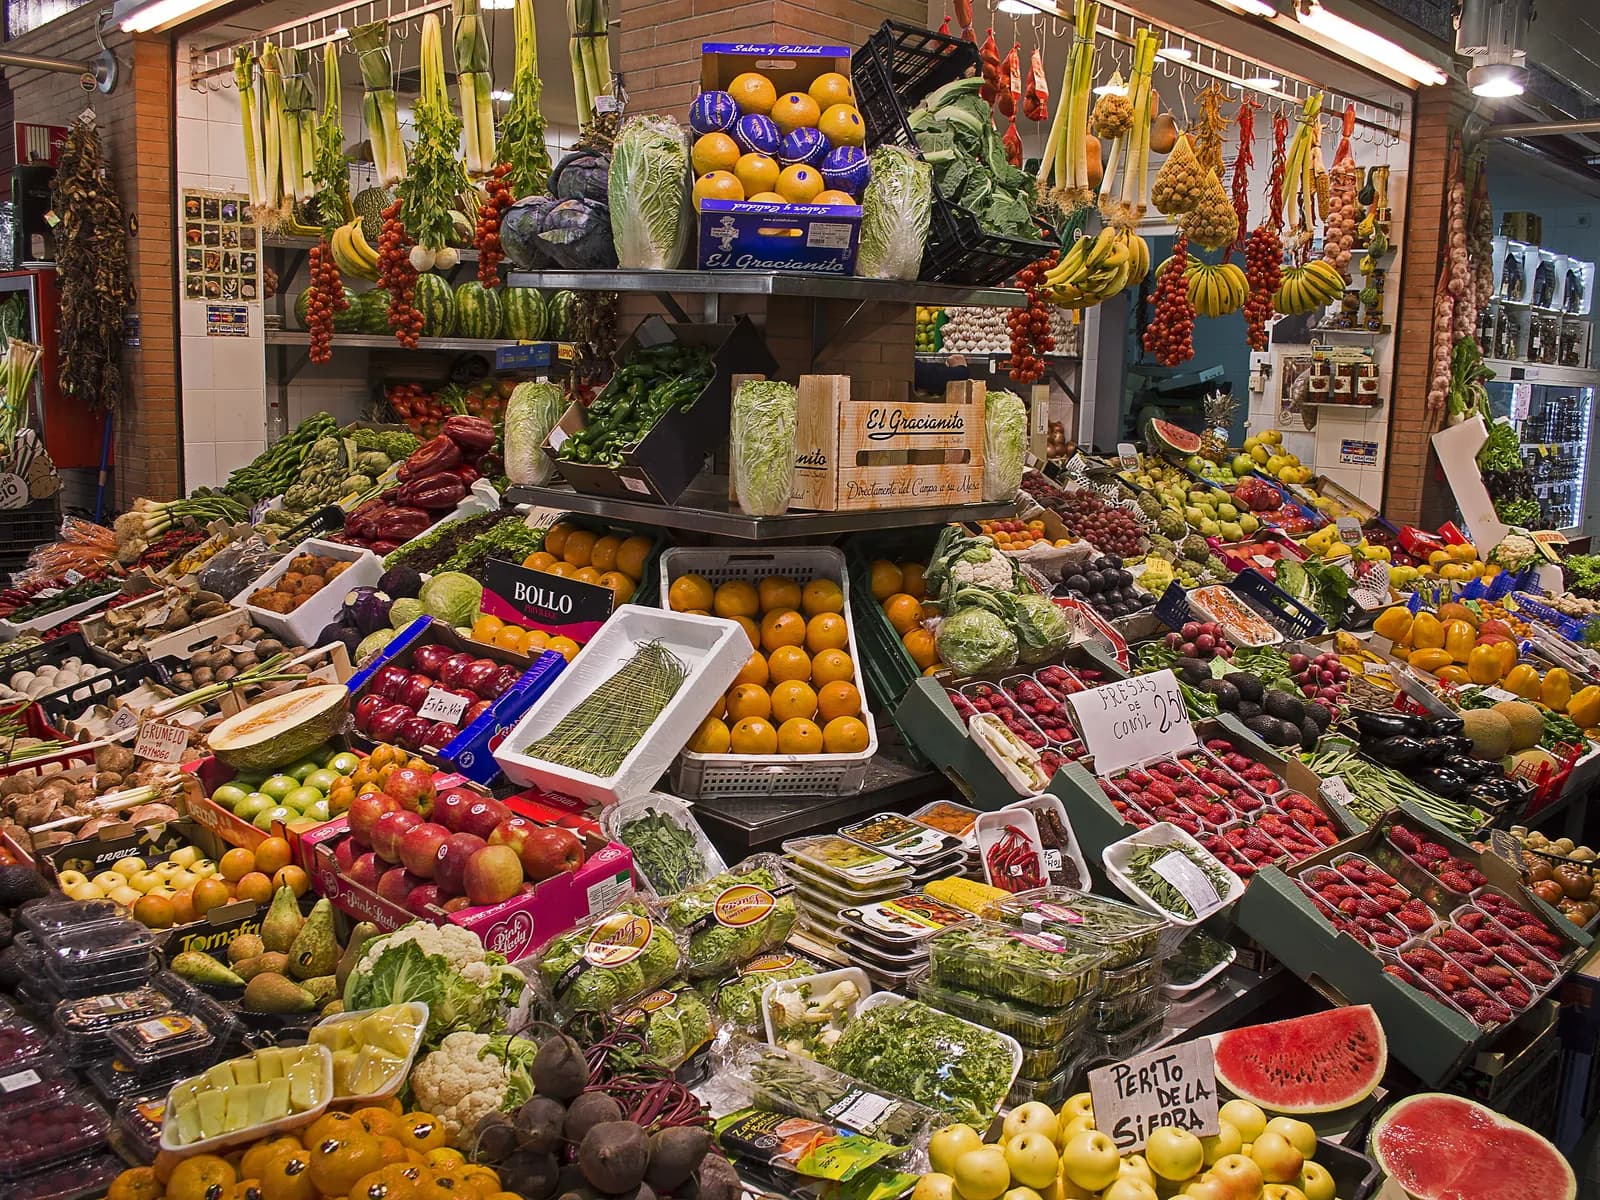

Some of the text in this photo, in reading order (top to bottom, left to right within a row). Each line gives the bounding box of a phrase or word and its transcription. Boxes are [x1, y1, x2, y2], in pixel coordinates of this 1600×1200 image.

[731, 44, 823, 55] Sabor y Calidad
[731, 203, 779, 213] Calidad
[792, 206, 831, 215] Sabor
[706, 253, 845, 272] El Gracianito
[866, 408, 964, 433] El Gracianito
[847, 481, 896, 499] Directamente
[898, 478, 909, 494] del
[911, 478, 938, 496] Campo
[514, 581, 573, 614] BOLLO
[1097, 676, 1157, 711] FRESAS
[1128, 700, 1142, 712] DE
[141, 723, 185, 745] GRUMELO
[340, 889, 372, 916] Pink
[494, 919, 522, 947] Pink
[497, 929, 527, 955] Lady
[1156, 1078, 1214, 1108] DE LA
